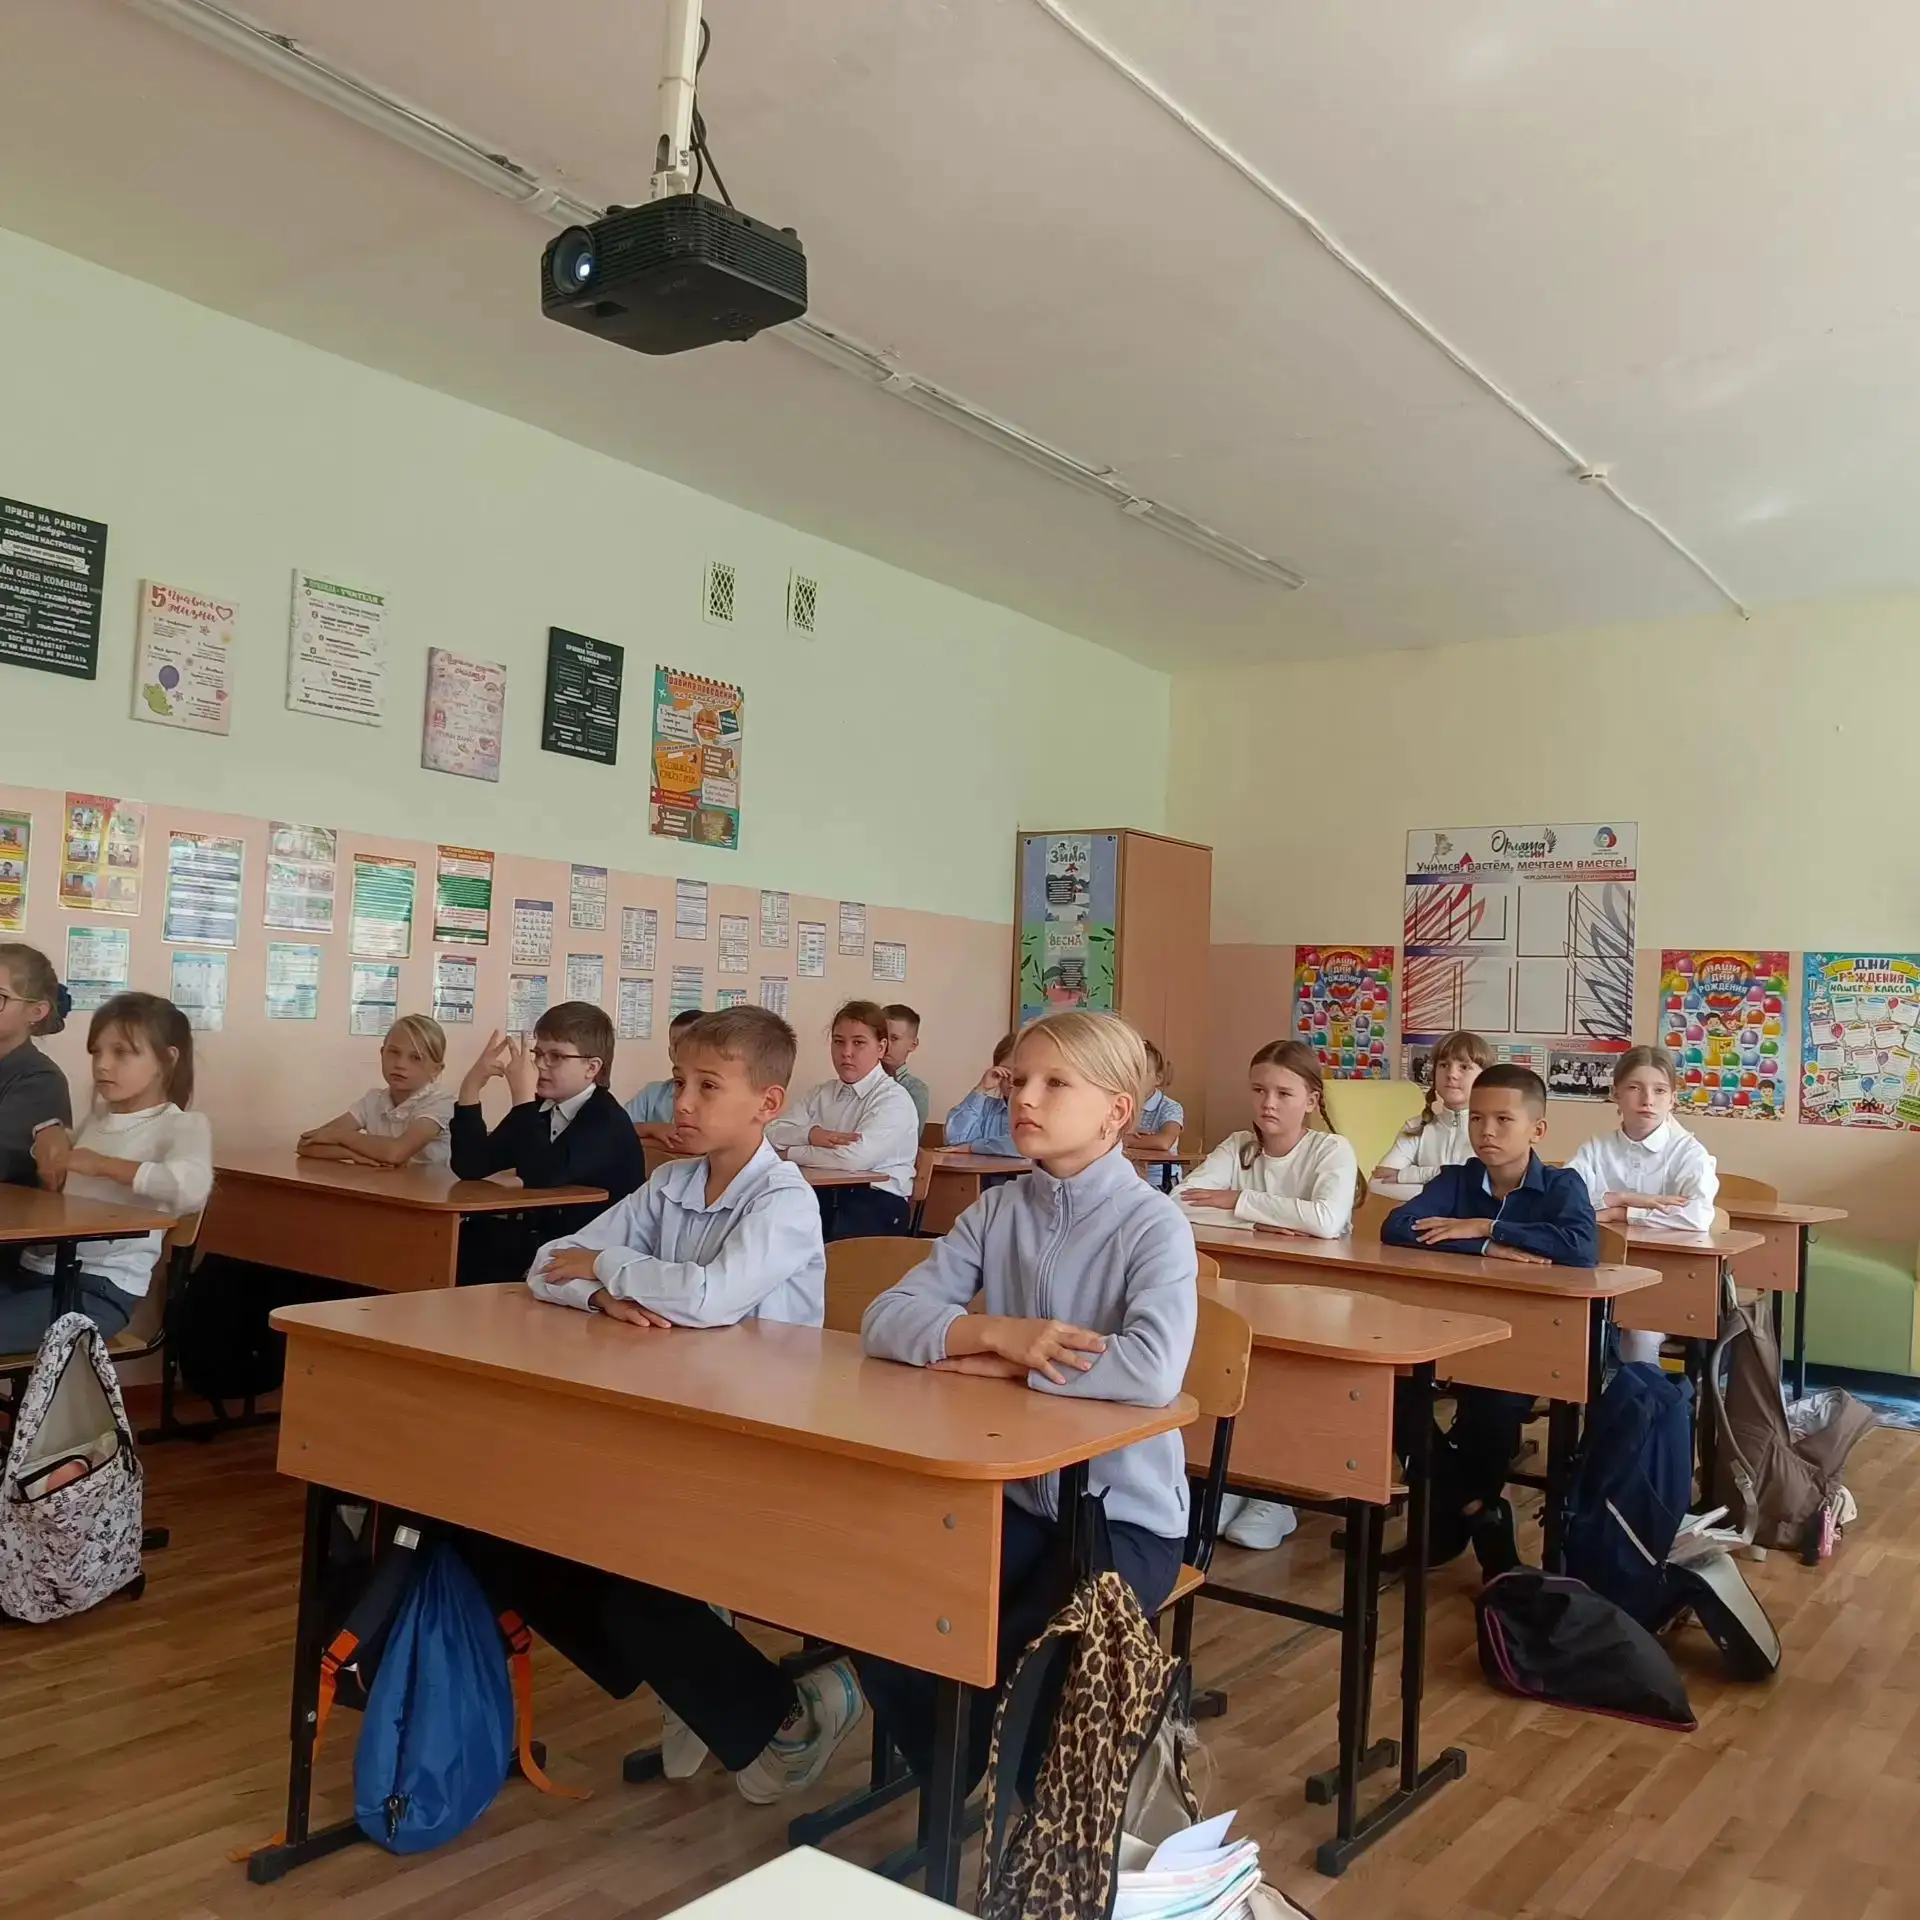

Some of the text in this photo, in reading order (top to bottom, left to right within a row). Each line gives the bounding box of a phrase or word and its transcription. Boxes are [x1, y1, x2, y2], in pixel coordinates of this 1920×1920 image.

[5, 504, 87, 533] ПРИДЯ НА РАБОТУ
[4, 528, 85, 553] ХОРОШЕЕ НАСТРОЕНИЕ
[16, 568, 41, 581] одна
[43, 575, 88, 592] команда
[152, 584, 167, 608] 5
[36, 640, 67, 651] РАБОТАЕТ
[20, 645, 44, 655] МЕШАЕТ
[56, 652, 87, 663] РАБОТАТЬ
[664, 674, 697, 691] Правила
[1491, 830, 1546, 855] Орлята
[1050, 850, 1087, 864] ЗИМА
[1417, 857, 1628, 873] Учимся, растём, мечтаем вместе!
[1049, 935, 1083, 947] ВЕСНА
[1333, 966, 1352, 974] ДНИ
[1707, 964, 1740, 973] НАШИ
[1854, 959, 1890, 970] ДНИ
[1711, 974, 1734, 982] ДНИ
[1699, 983, 1749, 995] РОЖДЕНИЯ
[1874, 983, 1913, 993] КЛАССА
